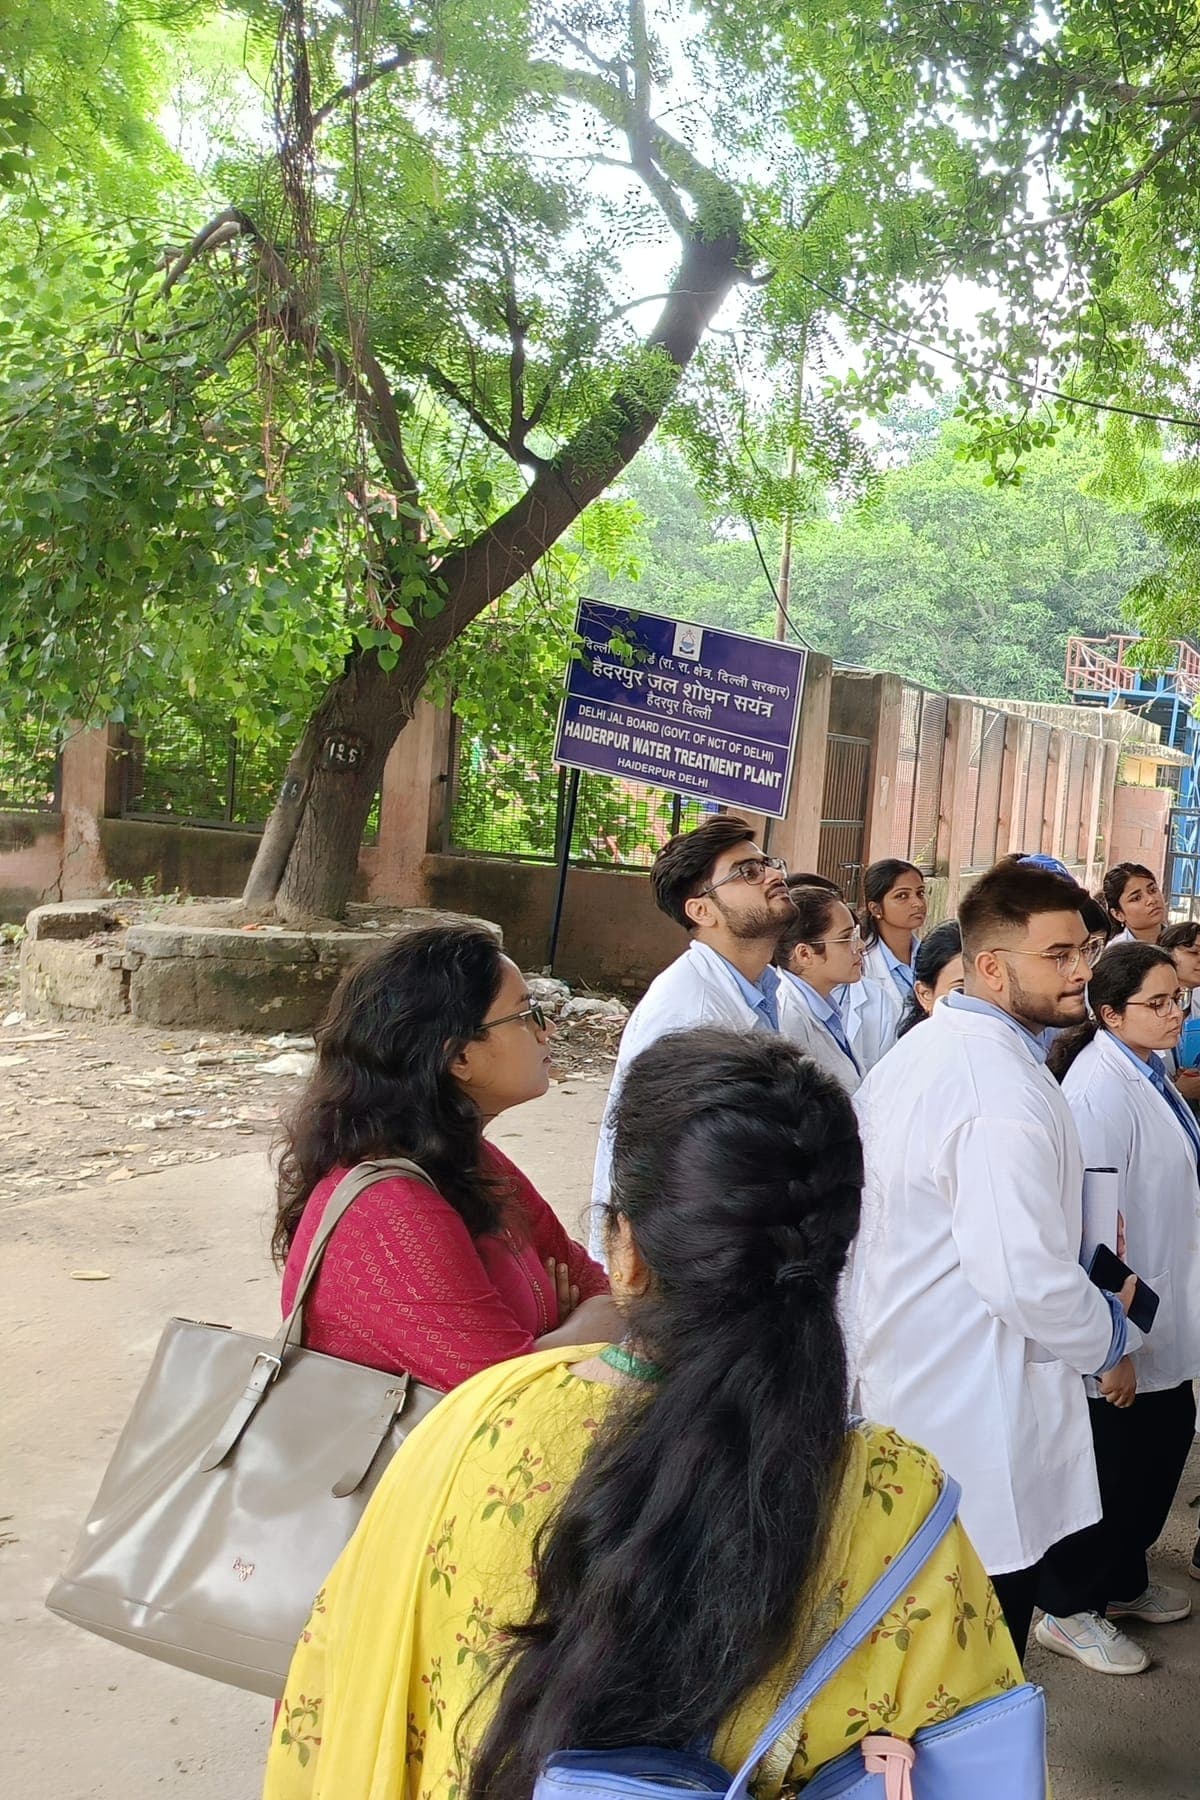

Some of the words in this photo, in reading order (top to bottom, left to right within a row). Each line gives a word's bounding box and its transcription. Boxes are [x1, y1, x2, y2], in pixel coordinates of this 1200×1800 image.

[592, 656, 644, 688] हैदरपुर
[648, 674, 679, 694] जल
[682, 680, 730, 707] शोधन
[734, 696, 774, 718] सयंत्र
[659, 656, 674, 670] (रा.
[678, 661, 691, 674] रा.
[718, 669, 749, 688] दिल्ली
[752, 680, 790, 700] सरकार)
[579, 704, 606, 720] DELHI
[607, 712, 624, 725] JAL
[626, 716, 659, 733] BOARD
[661, 724, 691, 742] (GOVT.
[693, 733, 706, 745] OF
[708, 736, 727, 750] NCT
[728, 742, 742, 754] OF
[743, 745, 774, 765] DELHI)
[682, 699, 712, 721] दिल्ली
[565, 720, 630, 751] HAIDERPUR
[632, 736, 671, 761] WATER
[674, 747, 742, 778] TREATMENT
[743, 765, 782, 789] PLANT
[617, 757, 676, 780] HAIDERPUR
[678, 772, 709, 788] DELHI
